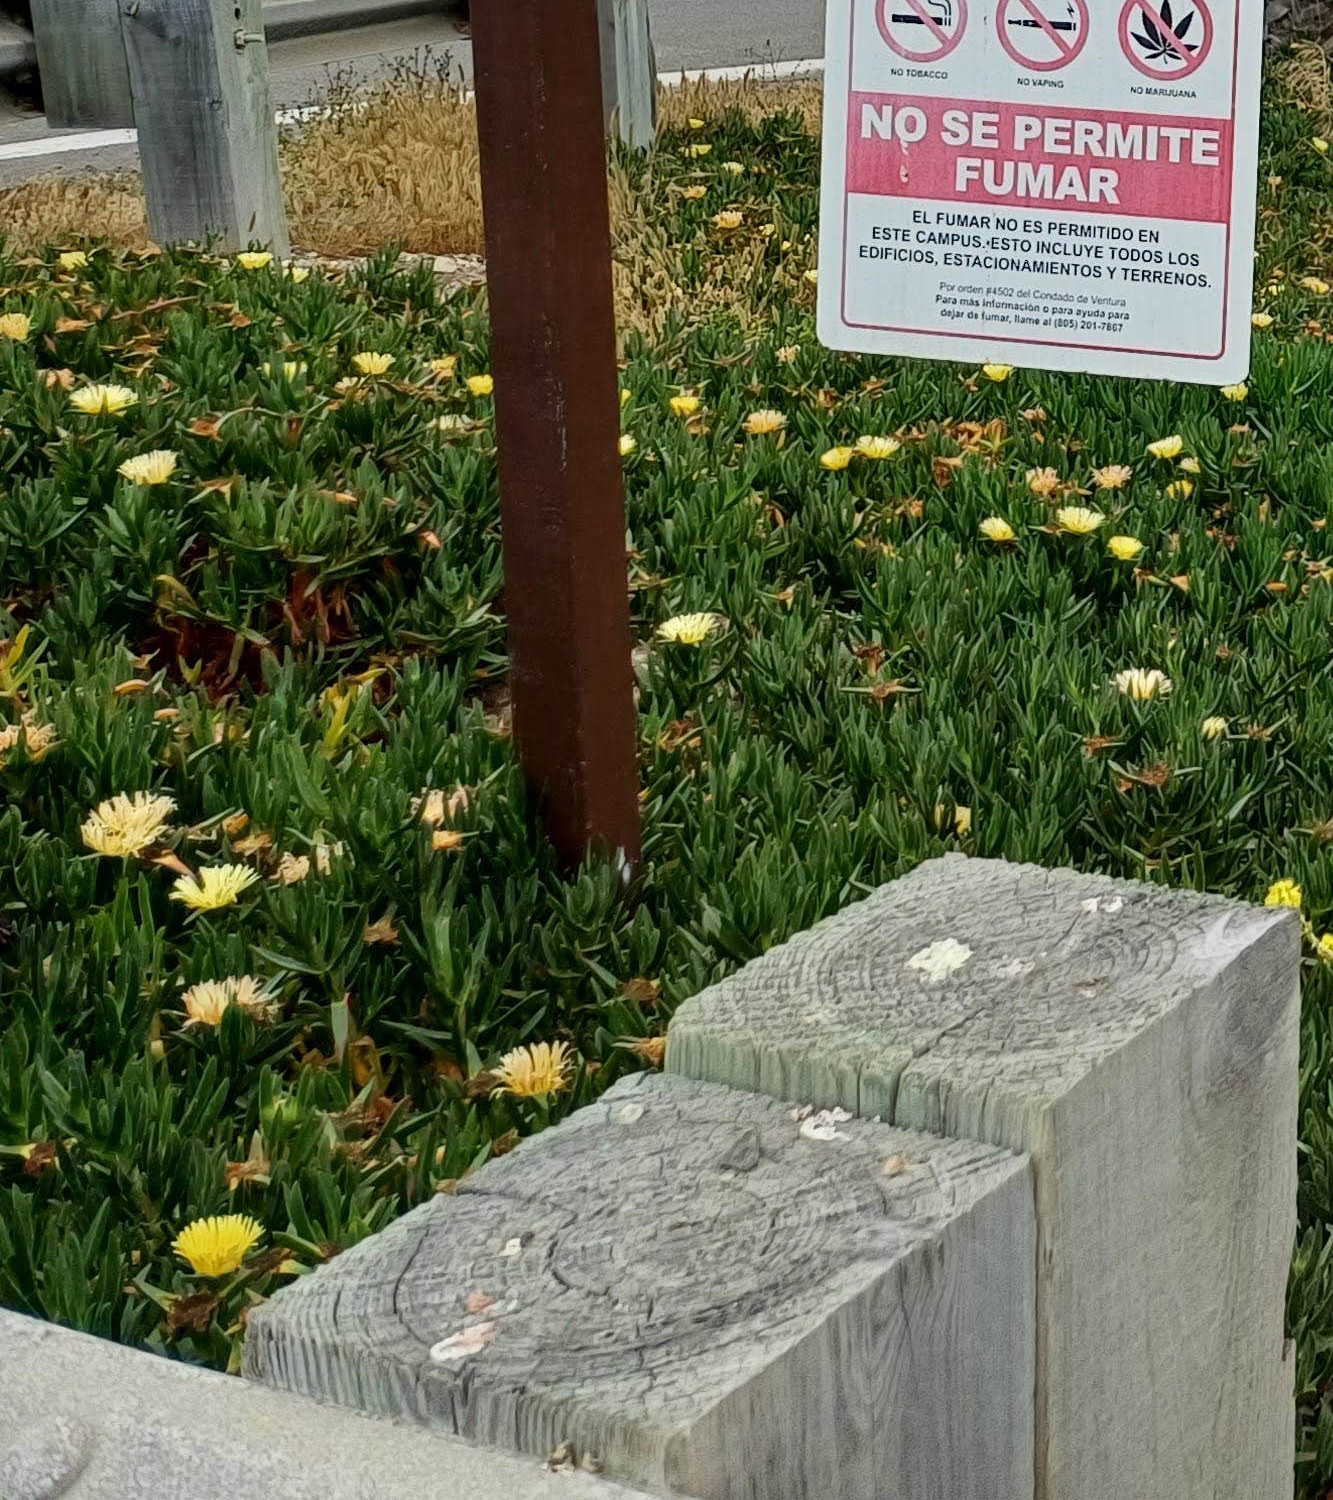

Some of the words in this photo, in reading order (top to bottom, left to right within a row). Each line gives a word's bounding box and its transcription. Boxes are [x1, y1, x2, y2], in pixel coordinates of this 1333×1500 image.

[890, 68, 904, 77] NO
[906, 69, 948, 80] TOBACCO
[1017, 77, 1030, 86] NO
[1032, 79, 1064, 89] VAPING
[1130, 86, 1143, 95] NO
[1145, 87, 1196, 99] MARIJUANA
[860, 103, 927, 142] NO
[940, 109, 999, 149] SE
[1014, 115, 1220, 166] PERMITE
[955, 157, 1120, 205] FUMAR
[913, 210, 931, 224] EL
[936, 212, 991, 229] FUMAR
[996, 217, 1018, 231] NO
[1023, 220, 1043, 234] ES
[1048, 222, 1134, 241] PERMITIDO
[1139, 229, 1159, 244] EN
[872, 227, 911, 242] ESTE
[916, 231, 985, 249] CAMPUS.
[991, 237, 1032, 252] ESTO
[1036, 241, 1104, 259] INCLUYE
[1109, 247, 1163, 264] TODOS
[1168, 252, 1200, 267] LOS
[859, 245, 939, 266] EDIFICIOS,
[944, 253, 1102, 278] ESTACIONAMIENTOS
[1107, 266, 1118, 279] Y
[1121, 267, 1212, 288] TERRENOS.
[936, 294, 957, 305] Para
[960, 296, 980, 307] más
[982, 299, 1040, 313] información
[1052, 306, 1073, 317] para
[1076, 307, 1106, 319] ayuda
[1108, 310, 1130, 321] para
[939, 282, 956, 292] Por
[958, 284, 983, 294] orden
[986, 286, 1014, 297] #4502
[1017, 288, 1031, 298] del
[1032, 290, 1074, 302] Condado
[1076, 294, 1088, 304] de
[1091, 295, 1126, 307] Ventura
[940, 308, 964, 320] dejar
[967, 310, 979, 319] de
[982, 312, 1012, 324] fumar,
[1015, 314, 1040, 325] llame
[1043, 318, 1051, 326] al
[1054, 318, 1078, 330] (805)
